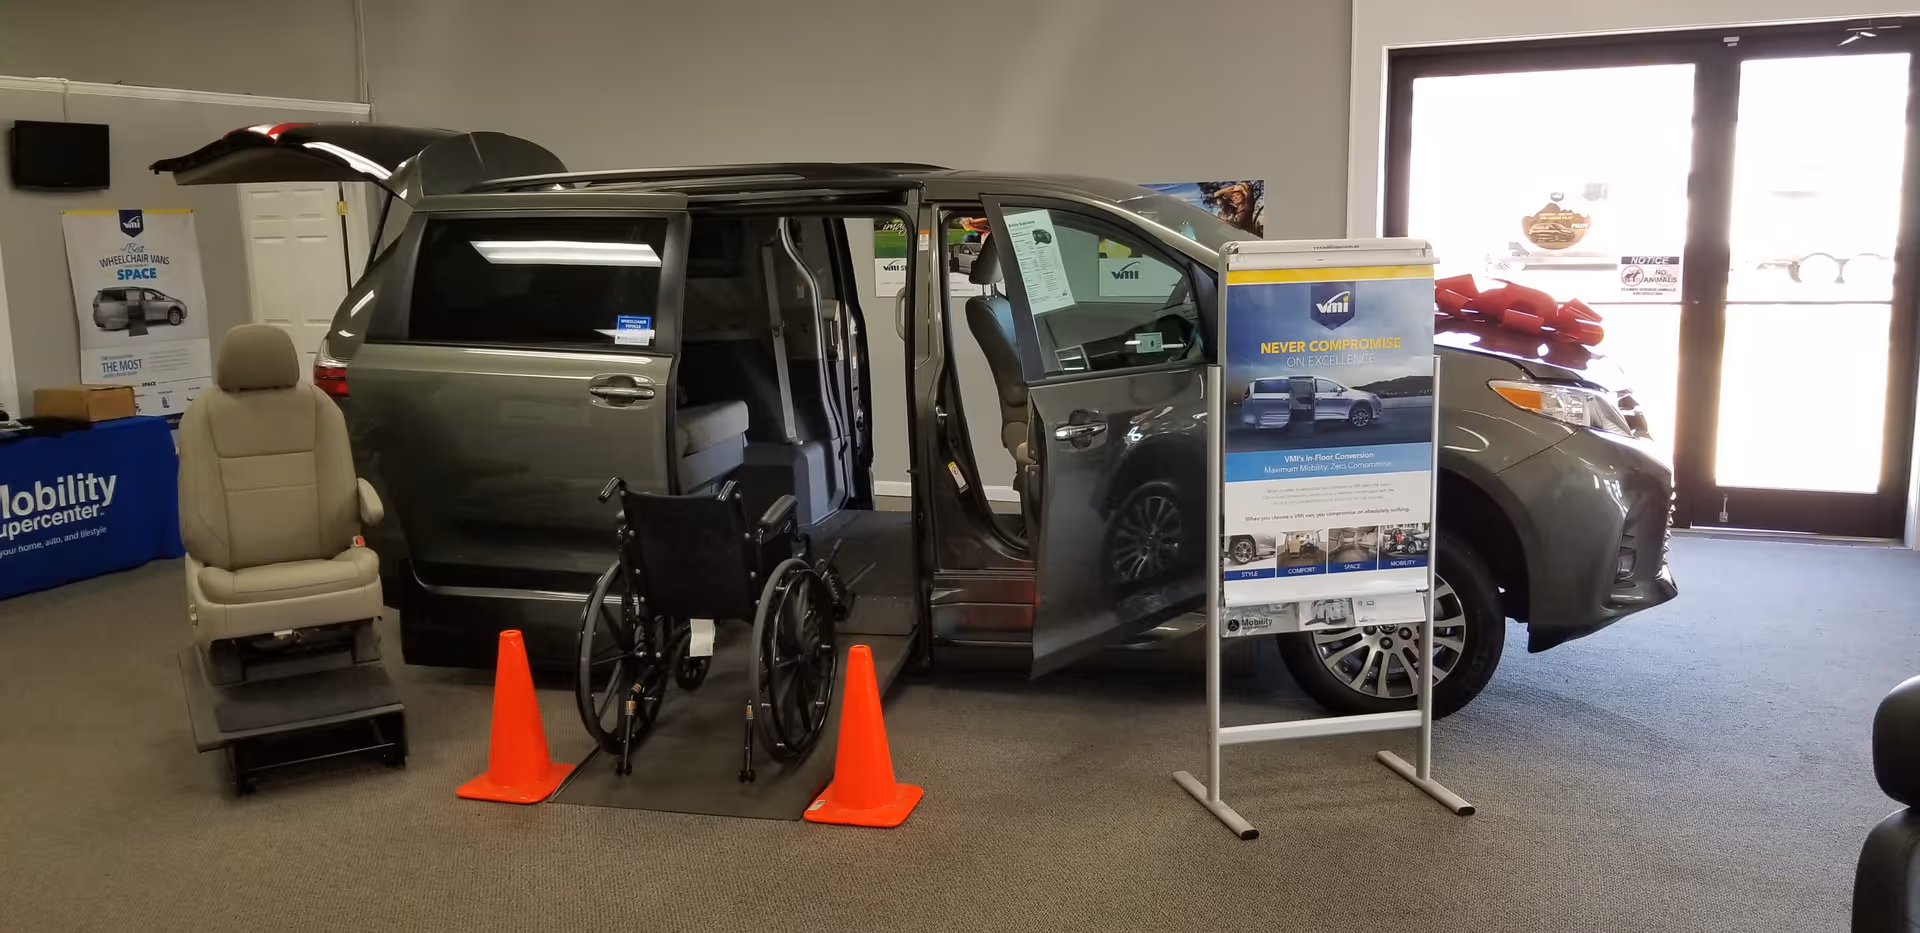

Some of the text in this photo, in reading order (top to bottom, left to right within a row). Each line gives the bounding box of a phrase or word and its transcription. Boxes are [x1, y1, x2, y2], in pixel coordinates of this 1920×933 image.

[1571, 222, 1590, 230] PILOT
[99, 253, 170, 268] WHEELCHAIR VANS
[1630, 256, 1670, 265] NOTICE
[117, 267, 157, 281] SPACE
[1260, 337, 1402, 355] NEVER COMPROMISE
[101, 361, 119, 373] THE
[119, 359, 142, 371] MOST
[1286, 353, 1377, 368] ON EXCELLENCE
[1284, 451, 1374, 463] VMI's In-Floor Conversion
[1264, 465, 1299, 474] Maximum
[1330, 462, 1347, 470] Zero
[18, 541, 44, 553] home,
[45, 536, 63, 547] auto,
[64, 531, 79, 542] and
[80, 526, 107, 538] lifestyle
[1390, 559, 1417, 567] MOBILITY
[1288, 566, 1316, 575] COMFORT
[1241, 617, 1273, 627] Mobility
